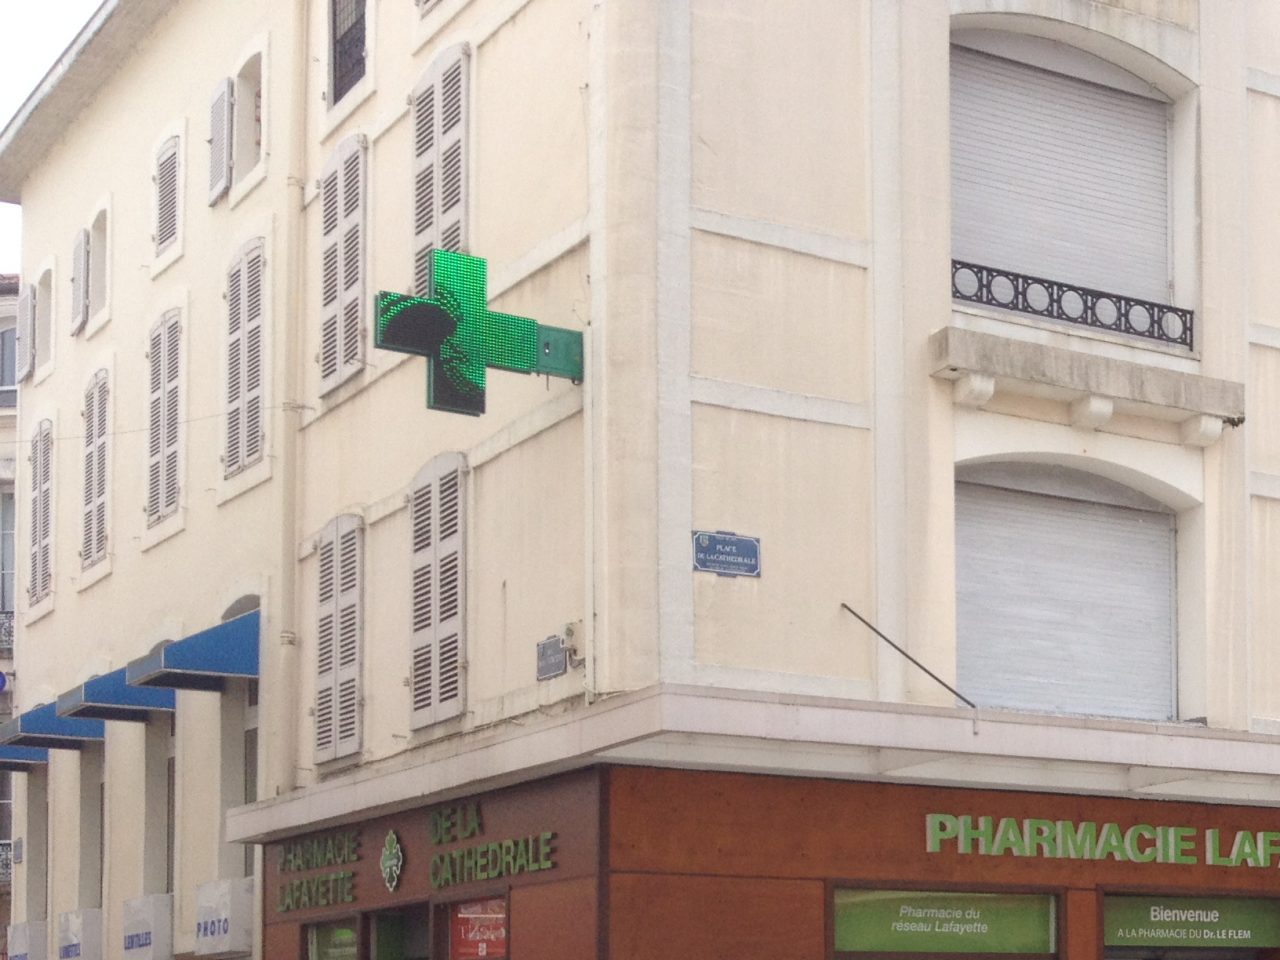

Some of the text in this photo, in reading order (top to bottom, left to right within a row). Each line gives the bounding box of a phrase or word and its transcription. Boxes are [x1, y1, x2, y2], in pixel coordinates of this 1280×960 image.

[716, 544, 737, 553] PLACE
[430, 802, 483, 845] DE LA
[925, 813, 1197, 864] PHARMACIE
[278, 828, 361, 874] PHARMACIE
[430, 831, 558, 889] CATHEDRALE
[277, 871, 356, 914] LAFAYETTE
[899, 905, 980, 919] Pharmacie du
[1150, 905, 1219, 922] Bienvenue
[196, 917, 230, 939] PHOTO
[891, 919, 988, 935] réseau Lafayette
[1117, 928, 1124, 938] A
[1125, 928, 1137, 938] LA
[1138, 928, 1188, 939] PHARMACIE
[1189, 929, 1202, 939] DU
[1228, 930, 1251, 939] FLEM
